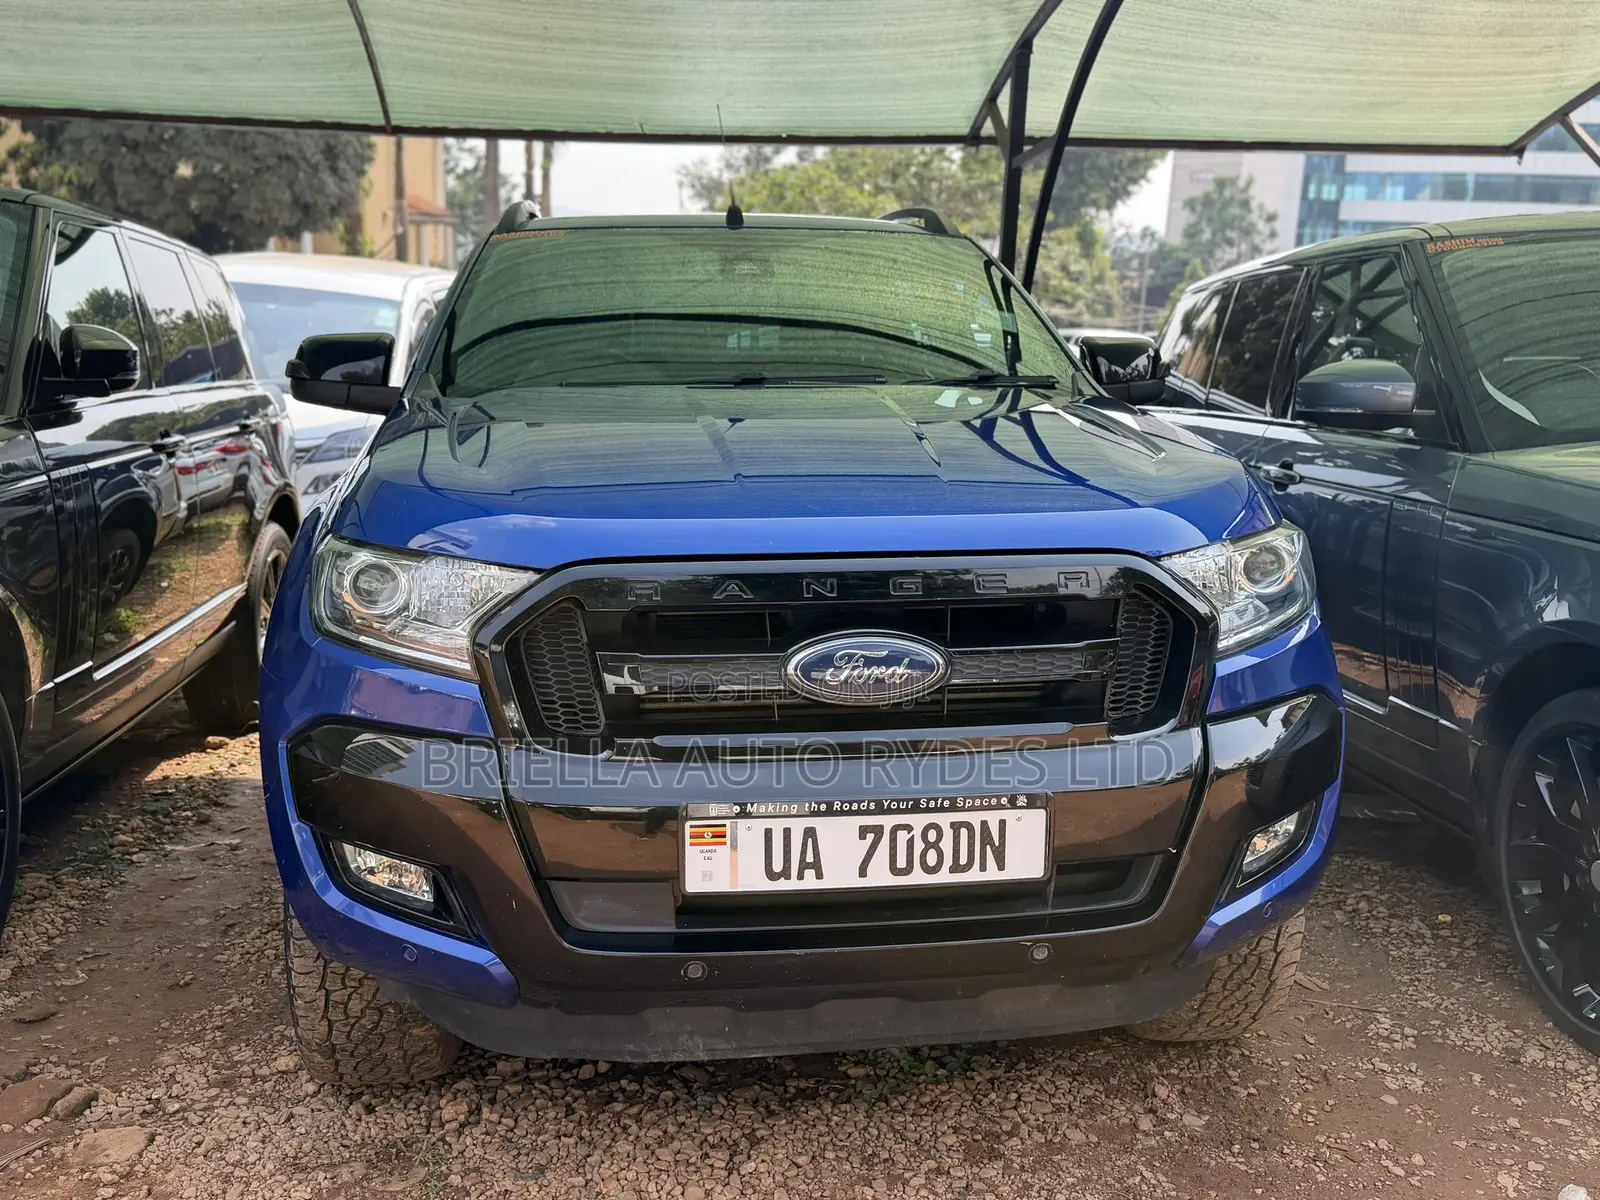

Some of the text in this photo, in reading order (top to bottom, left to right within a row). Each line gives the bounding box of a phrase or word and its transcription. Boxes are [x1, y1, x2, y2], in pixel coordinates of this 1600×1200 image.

[627, 571, 1091, 600] RANGER
[825, 649, 910, 686] Ford
[746, 796, 997, 815] Making the Roads Your Safe Space
[764, 818, 1007, 882] UA 708DN
